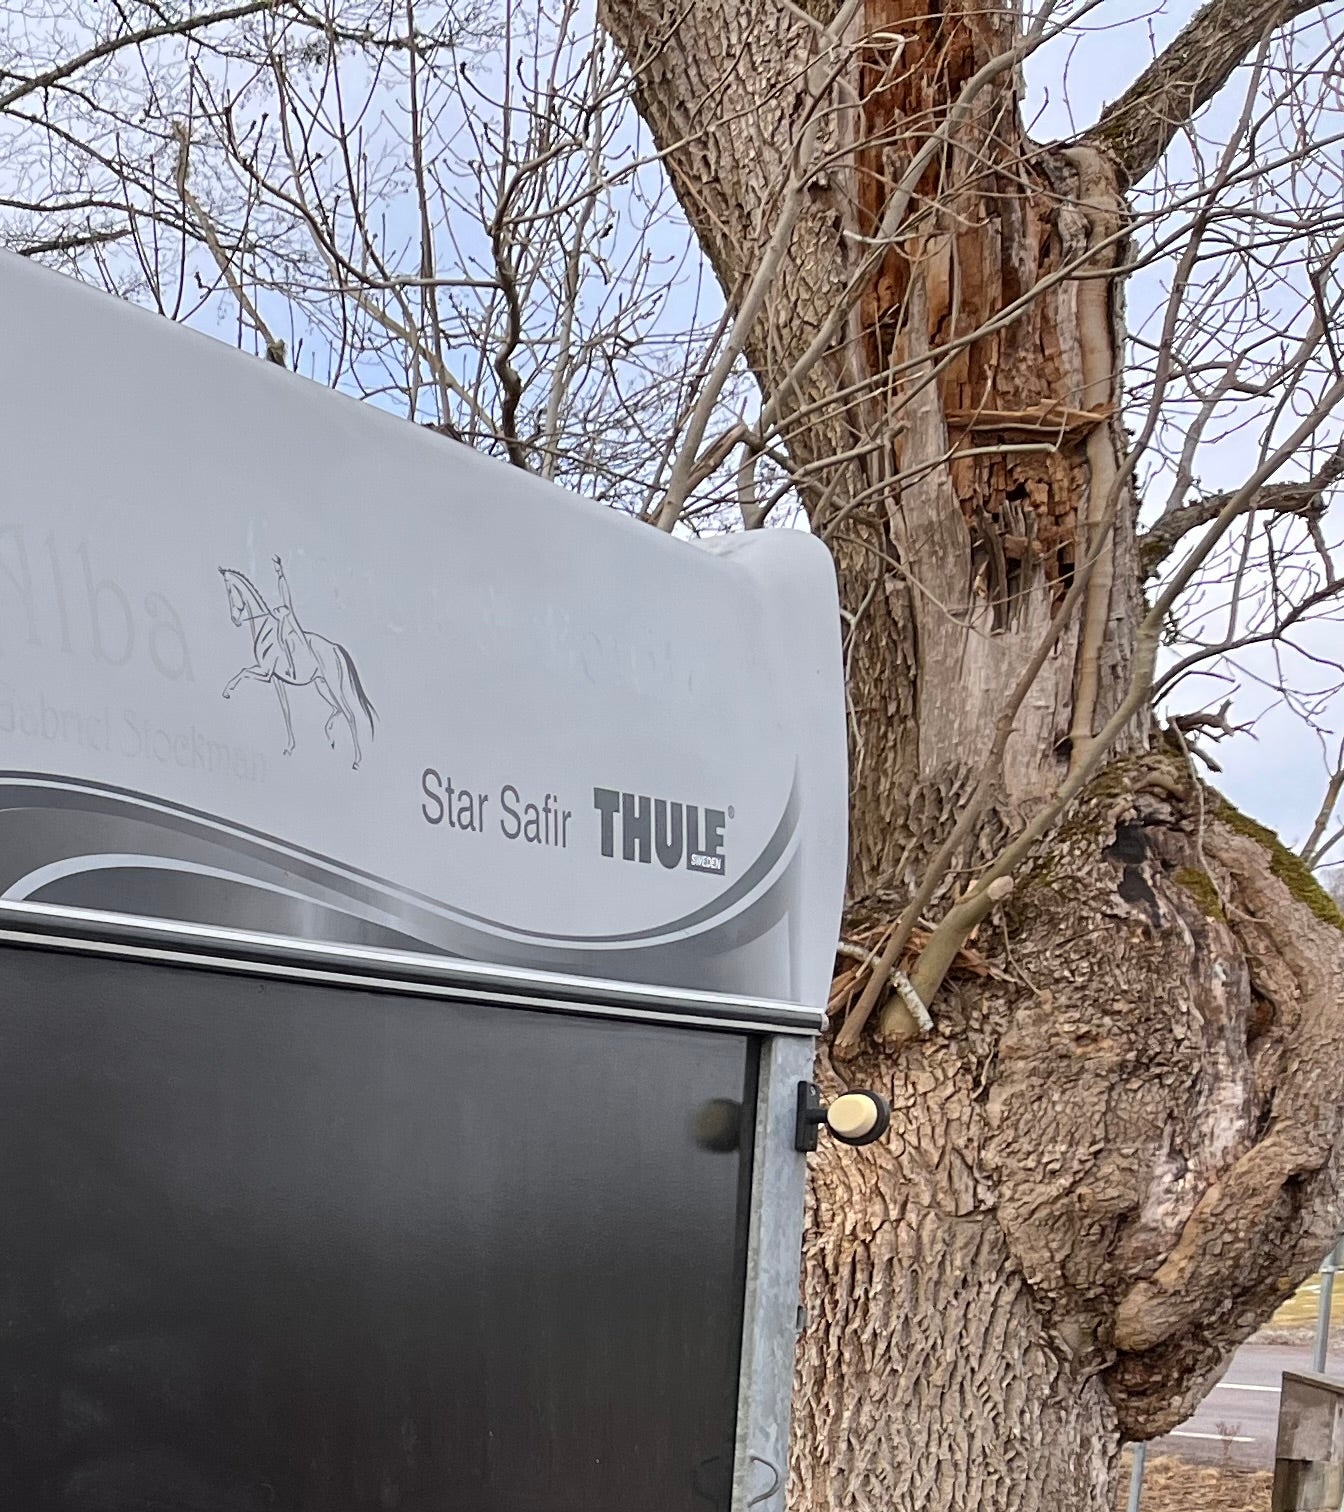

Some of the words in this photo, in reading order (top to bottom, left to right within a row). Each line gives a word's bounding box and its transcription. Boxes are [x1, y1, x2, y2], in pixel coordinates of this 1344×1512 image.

[421, 767, 489, 832] Star
[500, 784, 572, 848] Safir
[593, 786, 726, 875] THULE
[690, 853, 722, 870] SWEDEN
